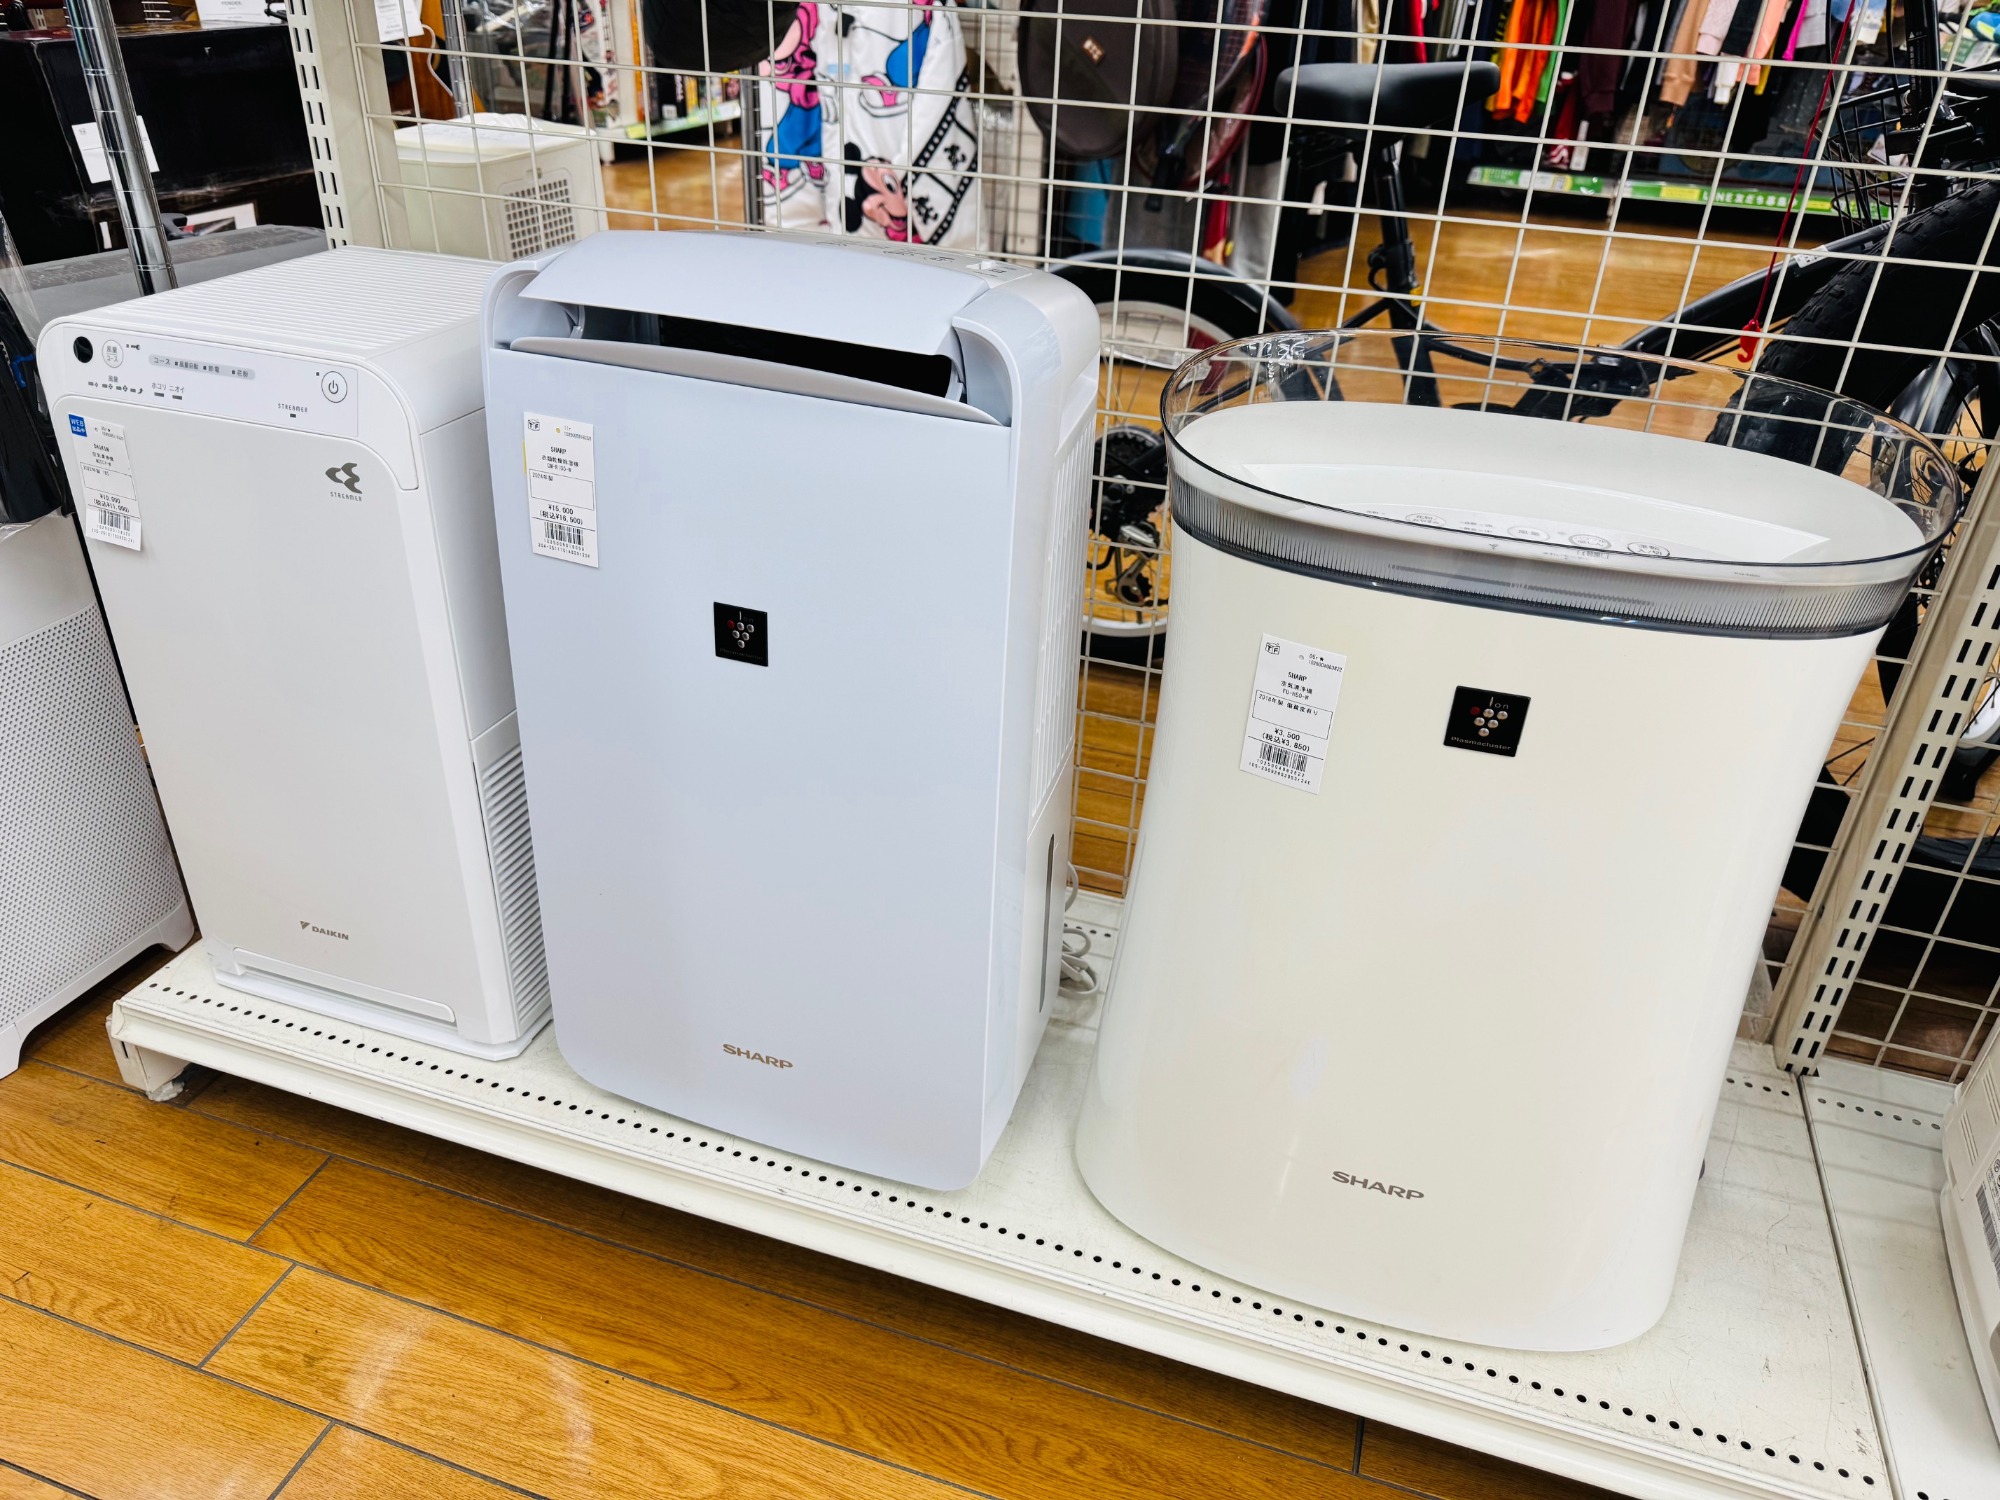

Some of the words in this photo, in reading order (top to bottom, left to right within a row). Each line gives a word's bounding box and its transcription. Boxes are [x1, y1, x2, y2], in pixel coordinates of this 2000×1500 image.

[107, 355, 119, 363] コース
[153, 356, 171, 366] コース
[151, 382, 167, 391] ホコリ
[169, 385, 185, 394] ニオイ
[277, 403, 308, 413] STREAMER
[71, 418, 84, 427] WEB
[330, 491, 362, 502] STREAMER
[1287, 671, 1308, 682] SHARP
[1489, 696, 1509, 710] Ion
[1451, 736, 1511, 751] Plasmacluster
[311, 925, 349, 941] DAIKIN
[722, 1043, 794, 1069] SHARP
[1331, 1170, 1425, 1200] SHARP
